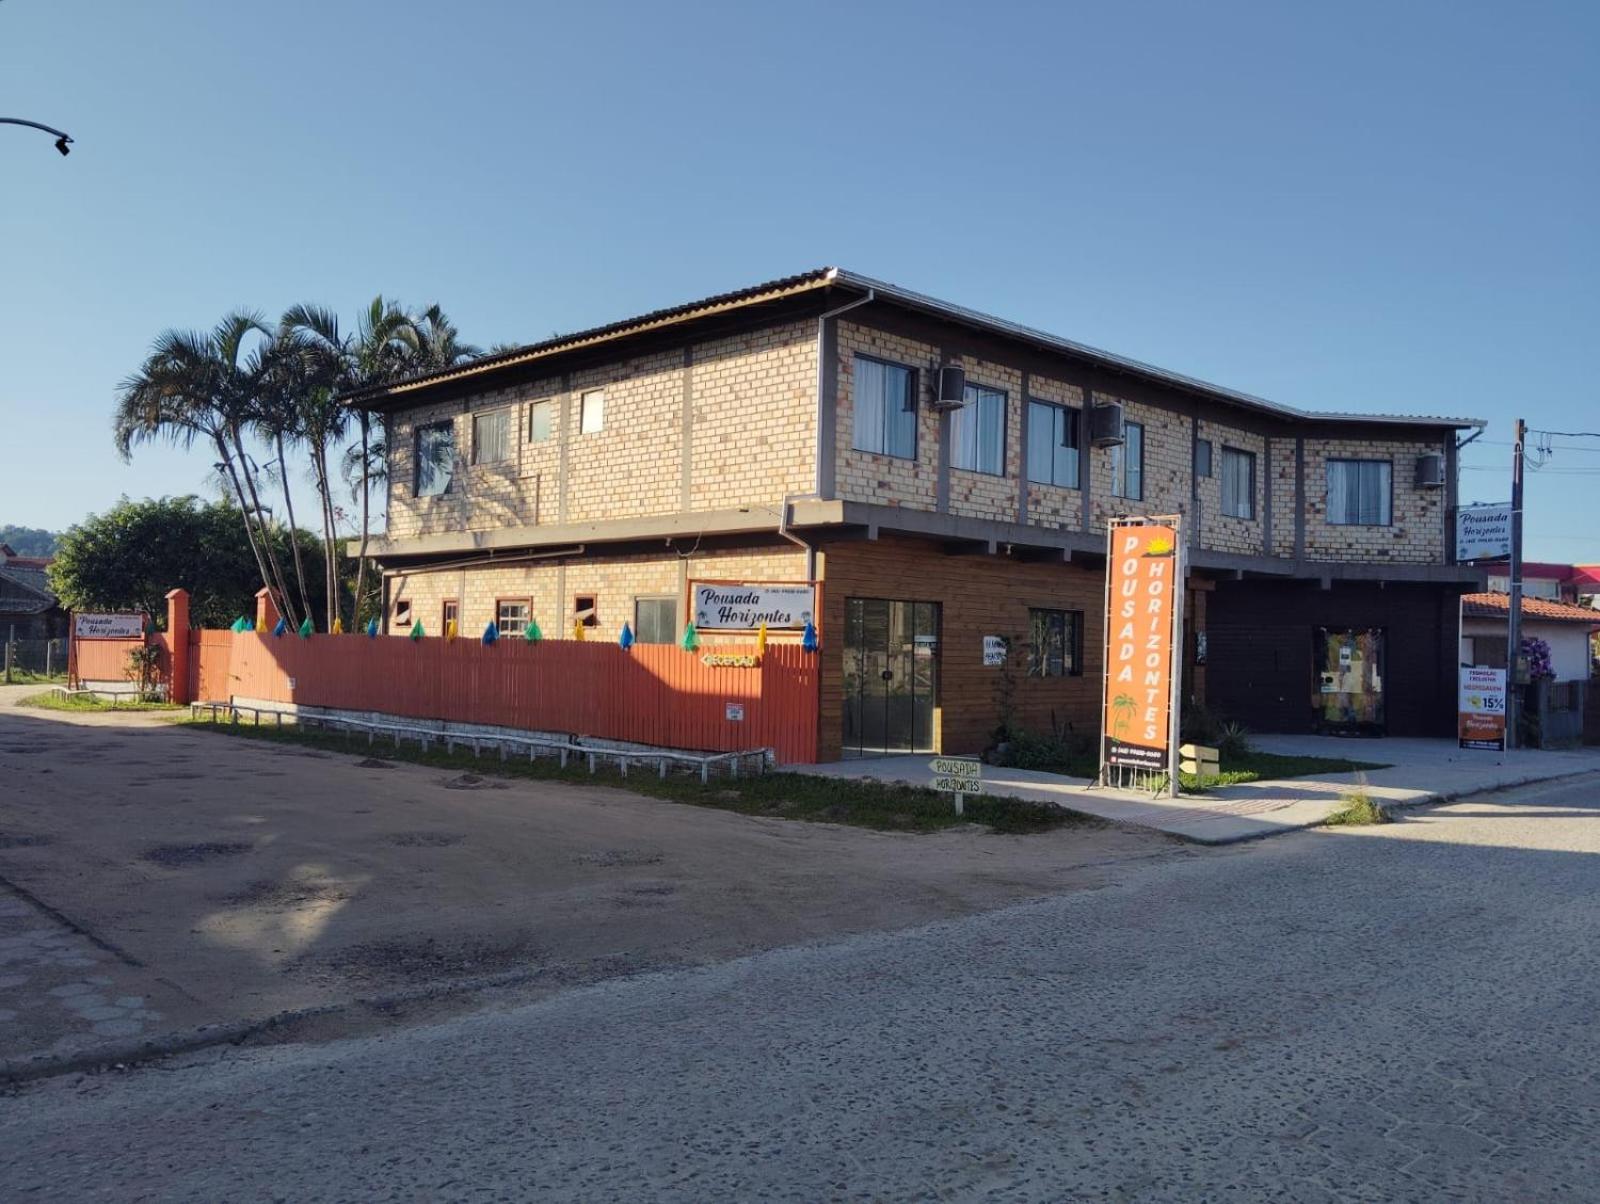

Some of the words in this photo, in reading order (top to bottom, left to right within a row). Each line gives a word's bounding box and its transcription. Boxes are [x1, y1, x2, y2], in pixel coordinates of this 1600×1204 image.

[1460, 513, 1508, 525] Pousada
[700, 588, 760, 605] Pousada
[718, 606, 792, 627] Horizontes
[1117, 536, 1139, 683] POUSADA
[80, 616, 113, 625] Pousada
[1143, 562, 1166, 741] HORIZONTES
[1483, 697, 1504, 709] 15%
[936, 760, 978, 775] POUSADA
